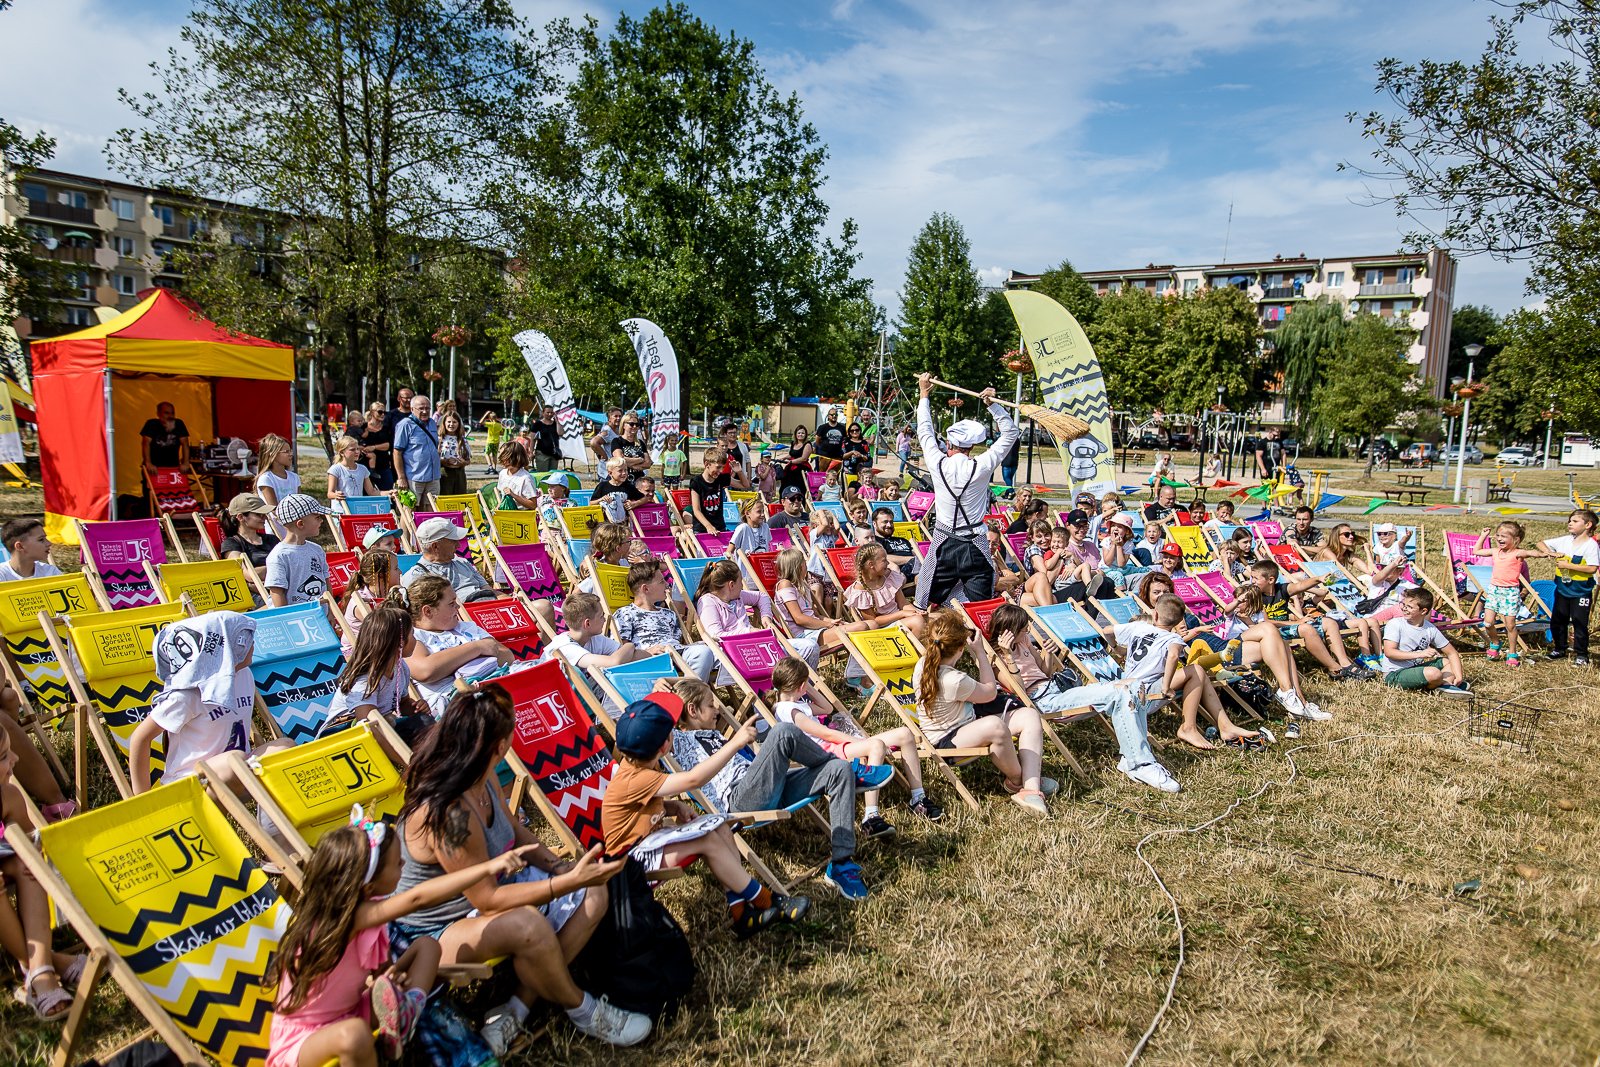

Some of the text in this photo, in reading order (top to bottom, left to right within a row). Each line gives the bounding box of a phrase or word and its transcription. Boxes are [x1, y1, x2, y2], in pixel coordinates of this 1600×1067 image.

[516, 523, 531, 540] JCK
[126, 539, 152, 562] JCK
[526, 560, 544, 580] JCK
[111, 582, 136, 593] Skok
[212, 578, 241, 605] JCK
[14, 595, 42, 606] Jelenio
[18, 604, 46, 612] Centrum
[49, 587, 85, 614] JCK
[1579, 597, 1590, 607] 93
[499, 606, 528, 629] JCK
[99, 631, 131, 645] Jelenio
[287, 616, 324, 646] JCK
[102, 643, 135, 653] Centrum
[104, 649, 136, 659] Kultury
[205, 632, 220, 656] SKOK
[886, 636, 911, 658] JCK
[276, 687, 309, 705] Skok
[311, 688, 325, 698] w
[208, 695, 252, 722] INSIRE
[514, 707, 534, 718] elenio
[537, 692, 574, 732] JCK
[517, 718, 541, 731] Centrum
[521, 726, 545, 738] Kultury
[291, 765, 325, 784] Jelenio
[331, 746, 382, 790] JCK
[549, 752, 610, 791] Skok w blok
[299, 778, 332, 793] Centrum
[303, 785, 337, 801] Kultury
[152, 820, 216, 875] JCK
[98, 847, 144, 874] Jelenio
[108, 861, 154, 884] Centrum
[113, 870, 159, 893] Kultury
[155, 893, 272, 962] Skok w blok
